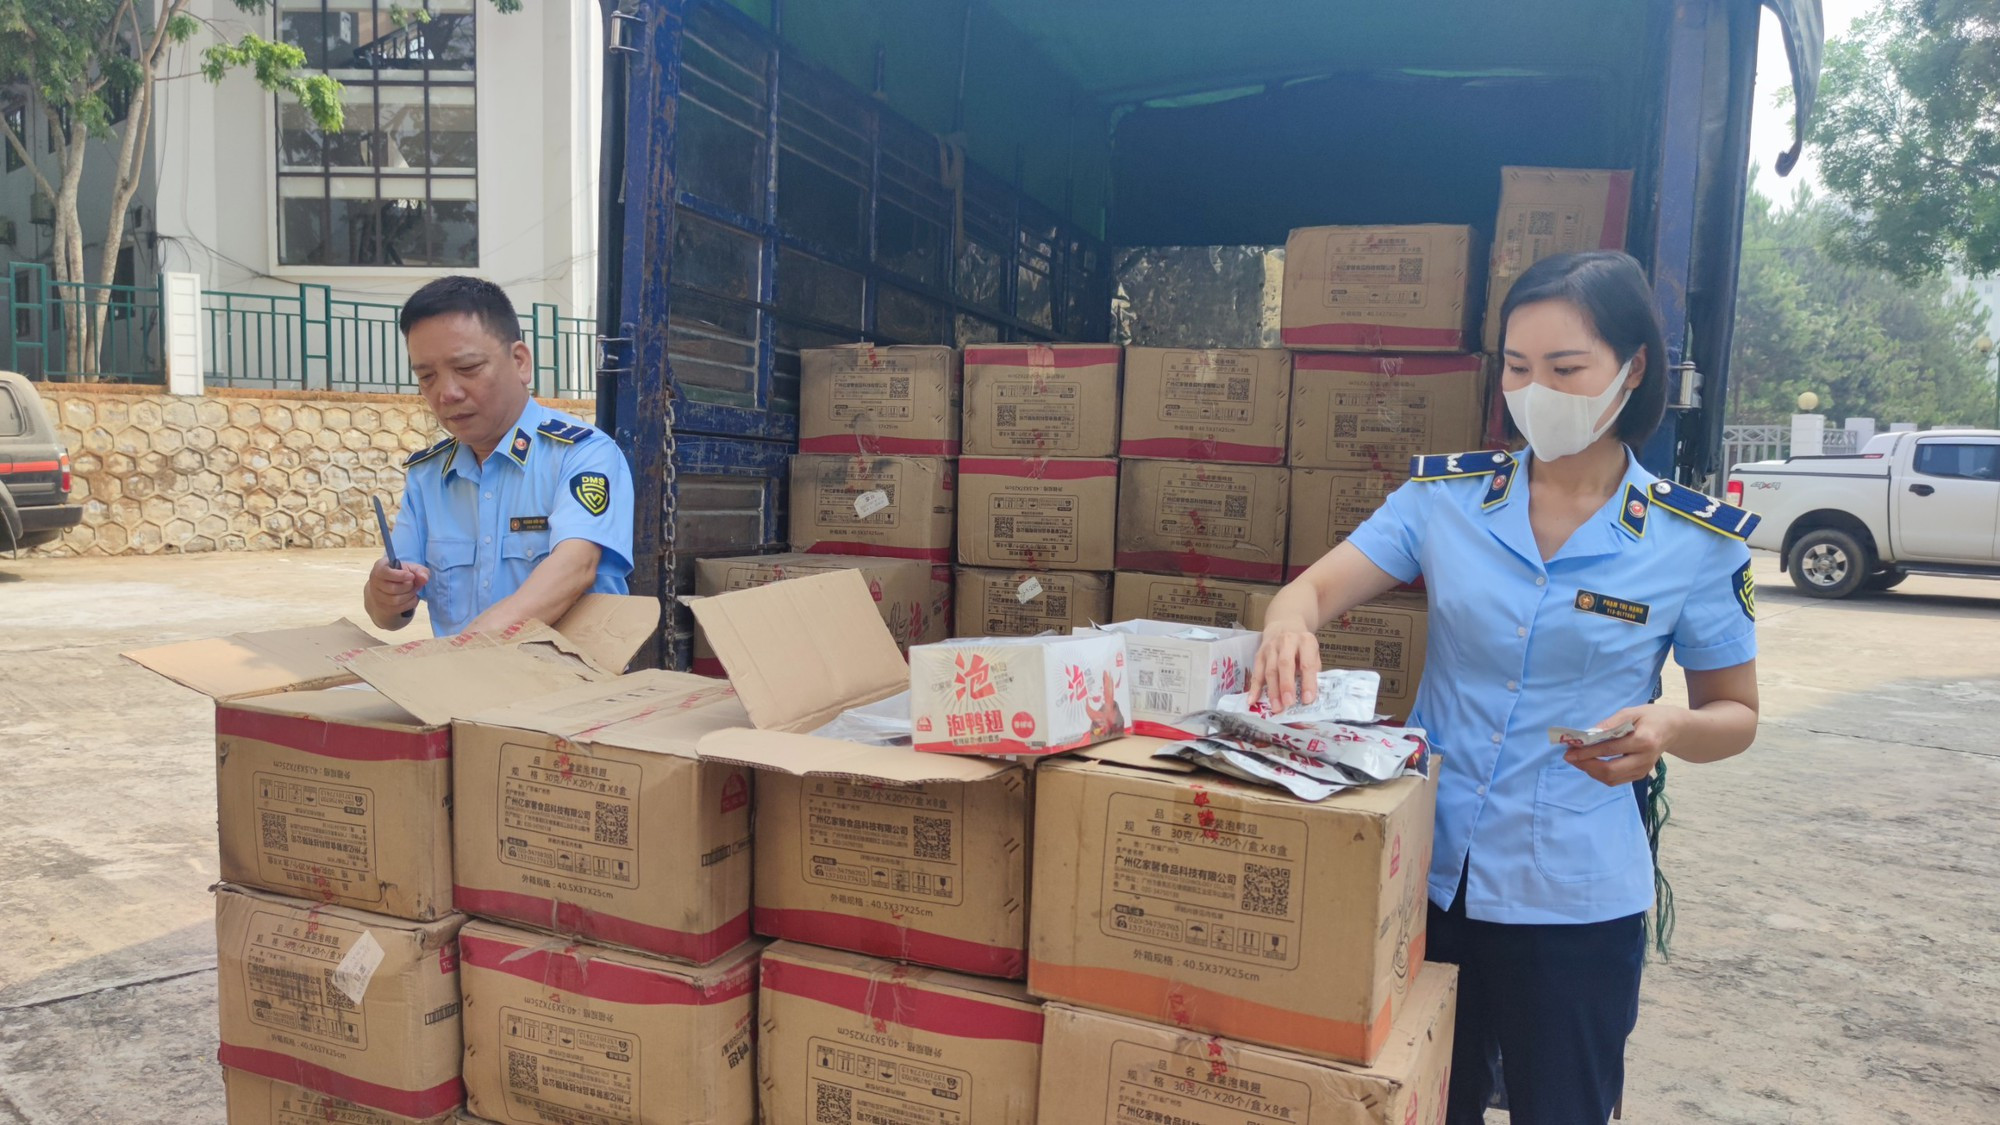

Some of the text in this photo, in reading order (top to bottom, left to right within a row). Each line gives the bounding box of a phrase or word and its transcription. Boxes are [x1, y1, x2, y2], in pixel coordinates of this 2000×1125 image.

[581, 476, 605, 486] DMS
[953, 651, 997, 702] 泡
[946, 709, 1004, 737] 泡鸭翅
[1154, 808, 1165, 820] 品
[1183, 812, 1193, 824] 名
[1124, 821, 1135, 832] 规
[1151, 824, 1162, 836] 格
[1113, 854, 1238, 887] 广州亿家馨食品科技有限公司
[1157, 1058, 1167, 1071] 品
[1185, 1066, 1195, 1078] 名
[1127, 1069, 1138, 1082] 规
[1153, 1076, 1165, 1089] 格
